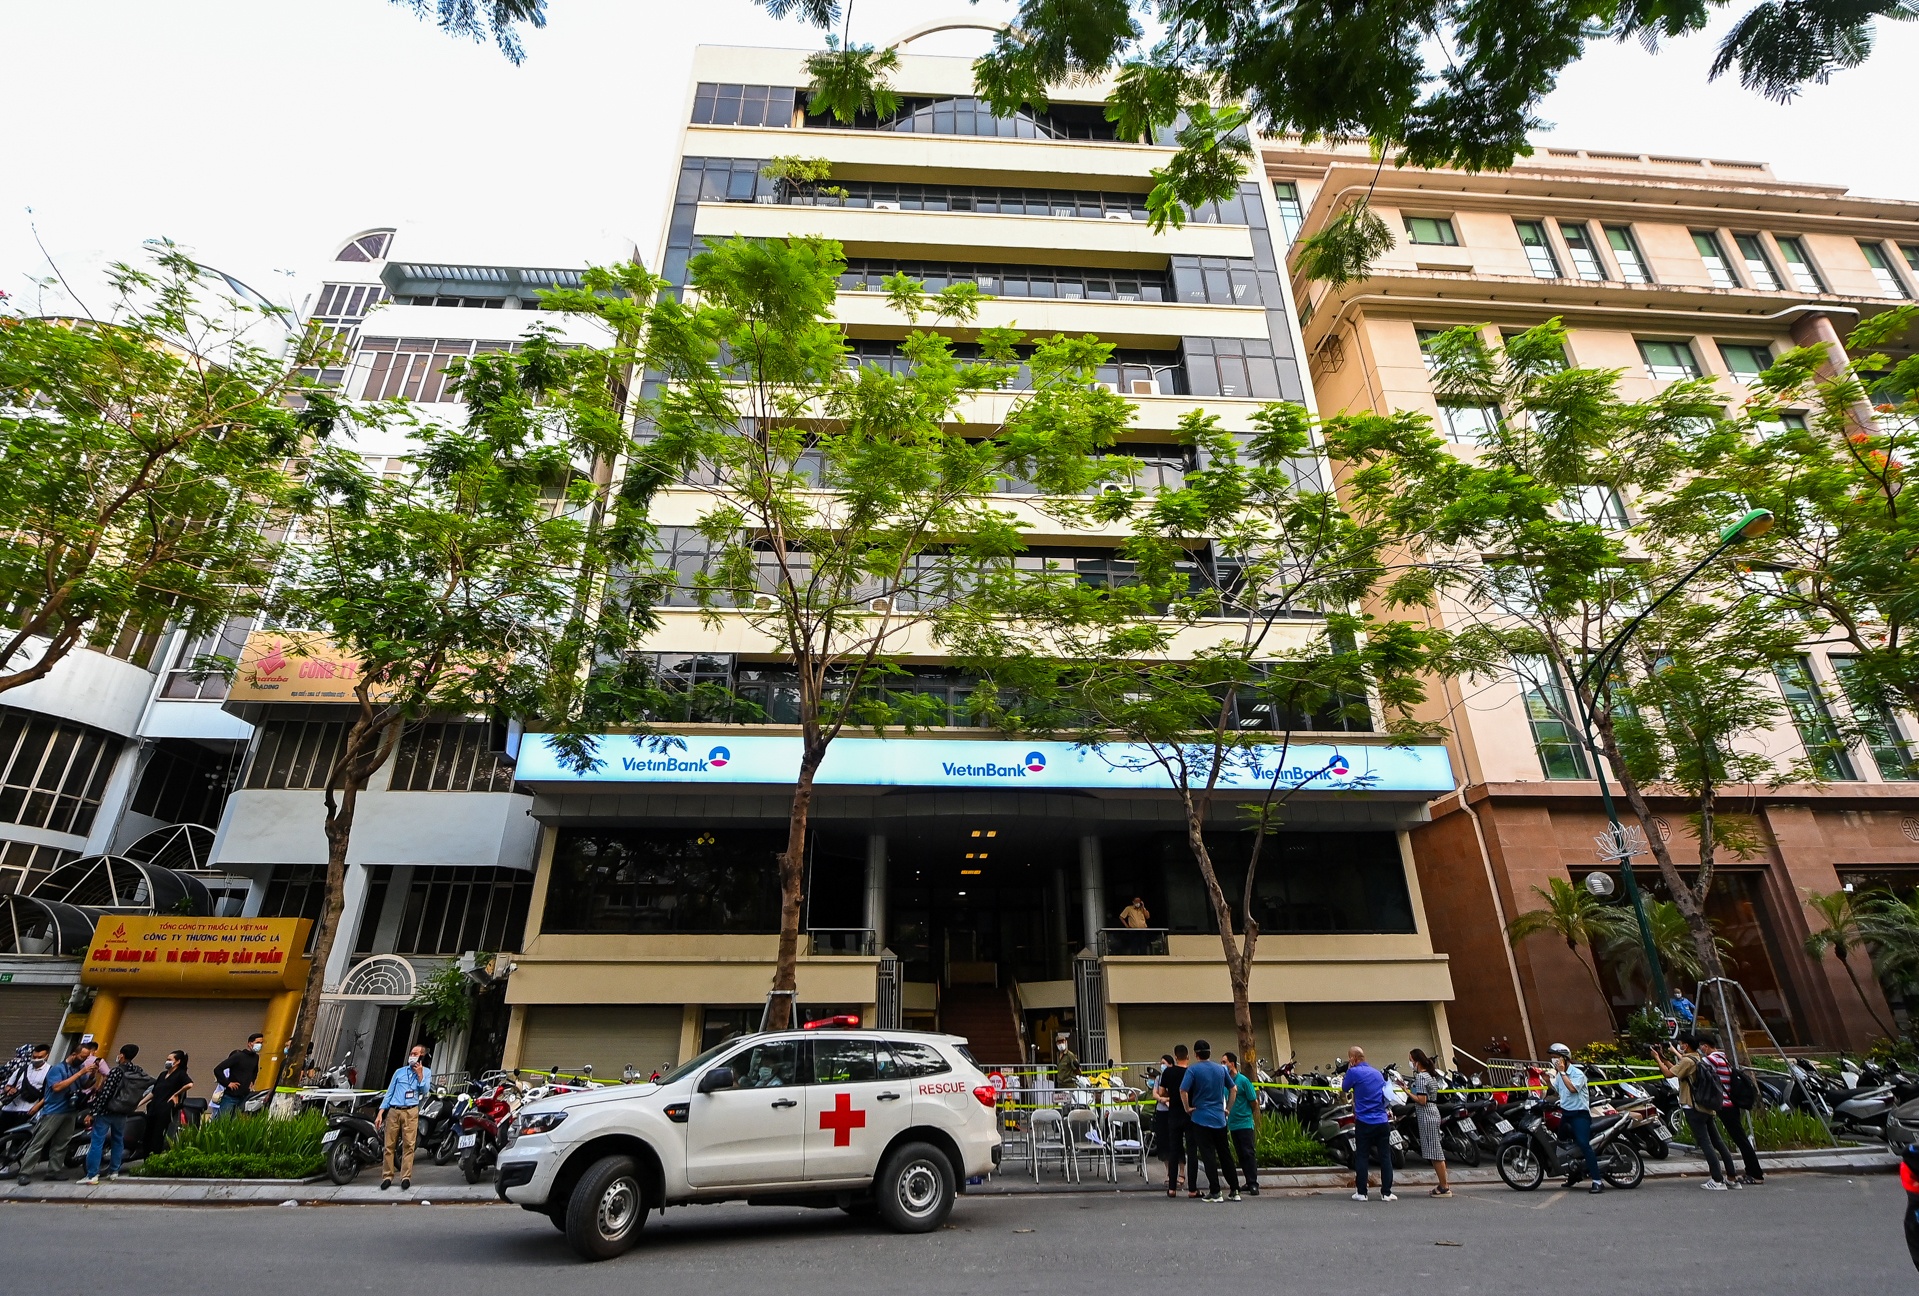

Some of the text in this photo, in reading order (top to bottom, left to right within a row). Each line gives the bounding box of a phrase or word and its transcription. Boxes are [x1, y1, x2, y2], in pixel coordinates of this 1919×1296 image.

[340, 662, 358, 679] TY
[622, 757, 708, 772] VietinBank
[942, 762, 1026, 777] VietinBank
[159, 922, 177, 930] TỔNG
[178, 923, 197, 931] CÔNG
[207, 923, 228, 931] THUỐC
[143, 933, 167, 941] CÔNG
[186, 934, 218, 942] THƯƠNG
[240, 933, 267, 942] THUỐC
[270, 934, 280, 942] LÁ
[232, 947, 253, 963] SẢN
[254, 946, 283, 964] PHẨM
[919, 1081, 966, 1095] RESCUE
